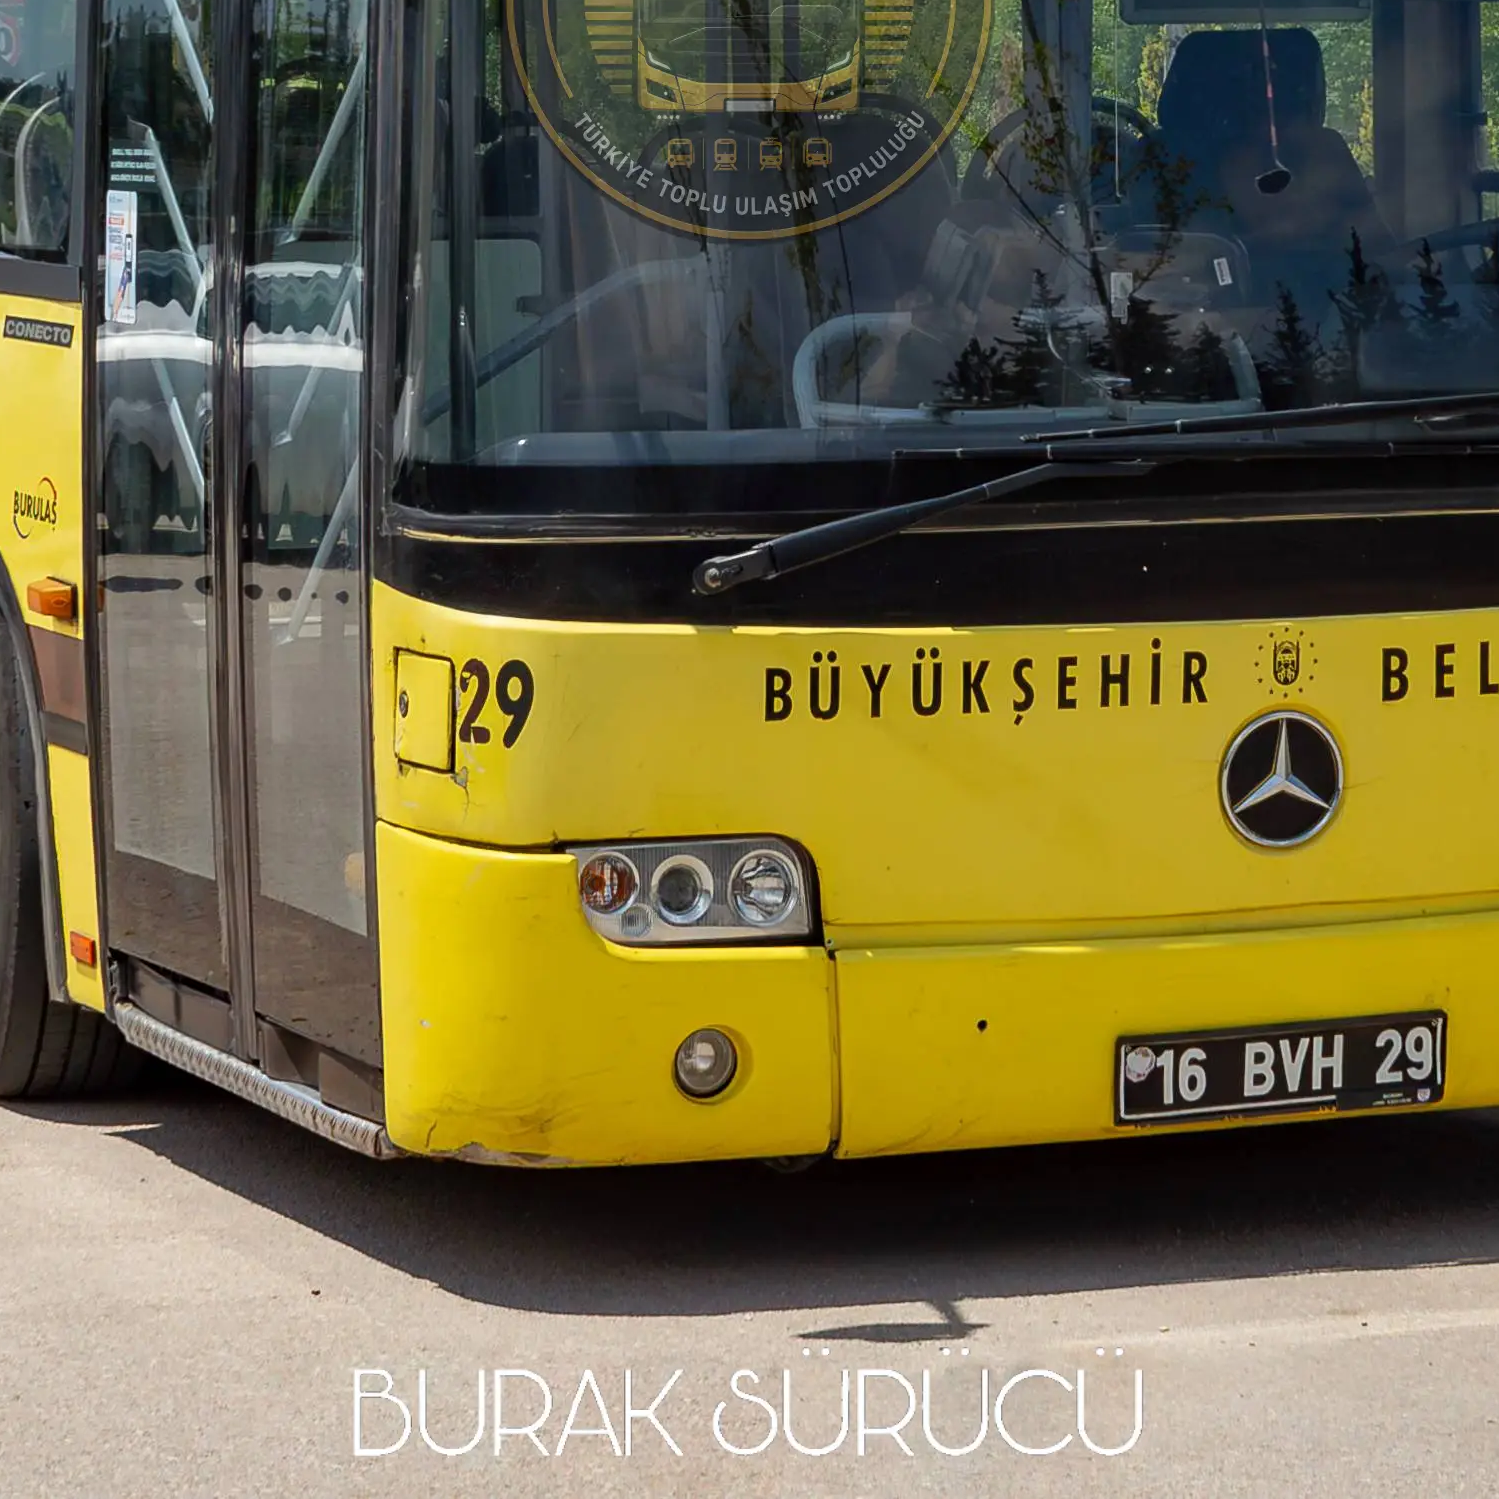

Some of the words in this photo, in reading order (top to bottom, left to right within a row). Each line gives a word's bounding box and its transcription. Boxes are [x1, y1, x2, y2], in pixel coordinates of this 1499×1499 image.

[6, 319, 74, 347] CONECTO
[13, 488, 58, 532] BURULAŞ
[459, 657, 535, 750] 29
[763, 637, 1209, 726] BÜYÜKŞEHİR
[1155, 1047, 1208, 1106] 16
[1243, 1033, 1345, 1098] BVH
[1374, 1026, 1434, 1085] 29
